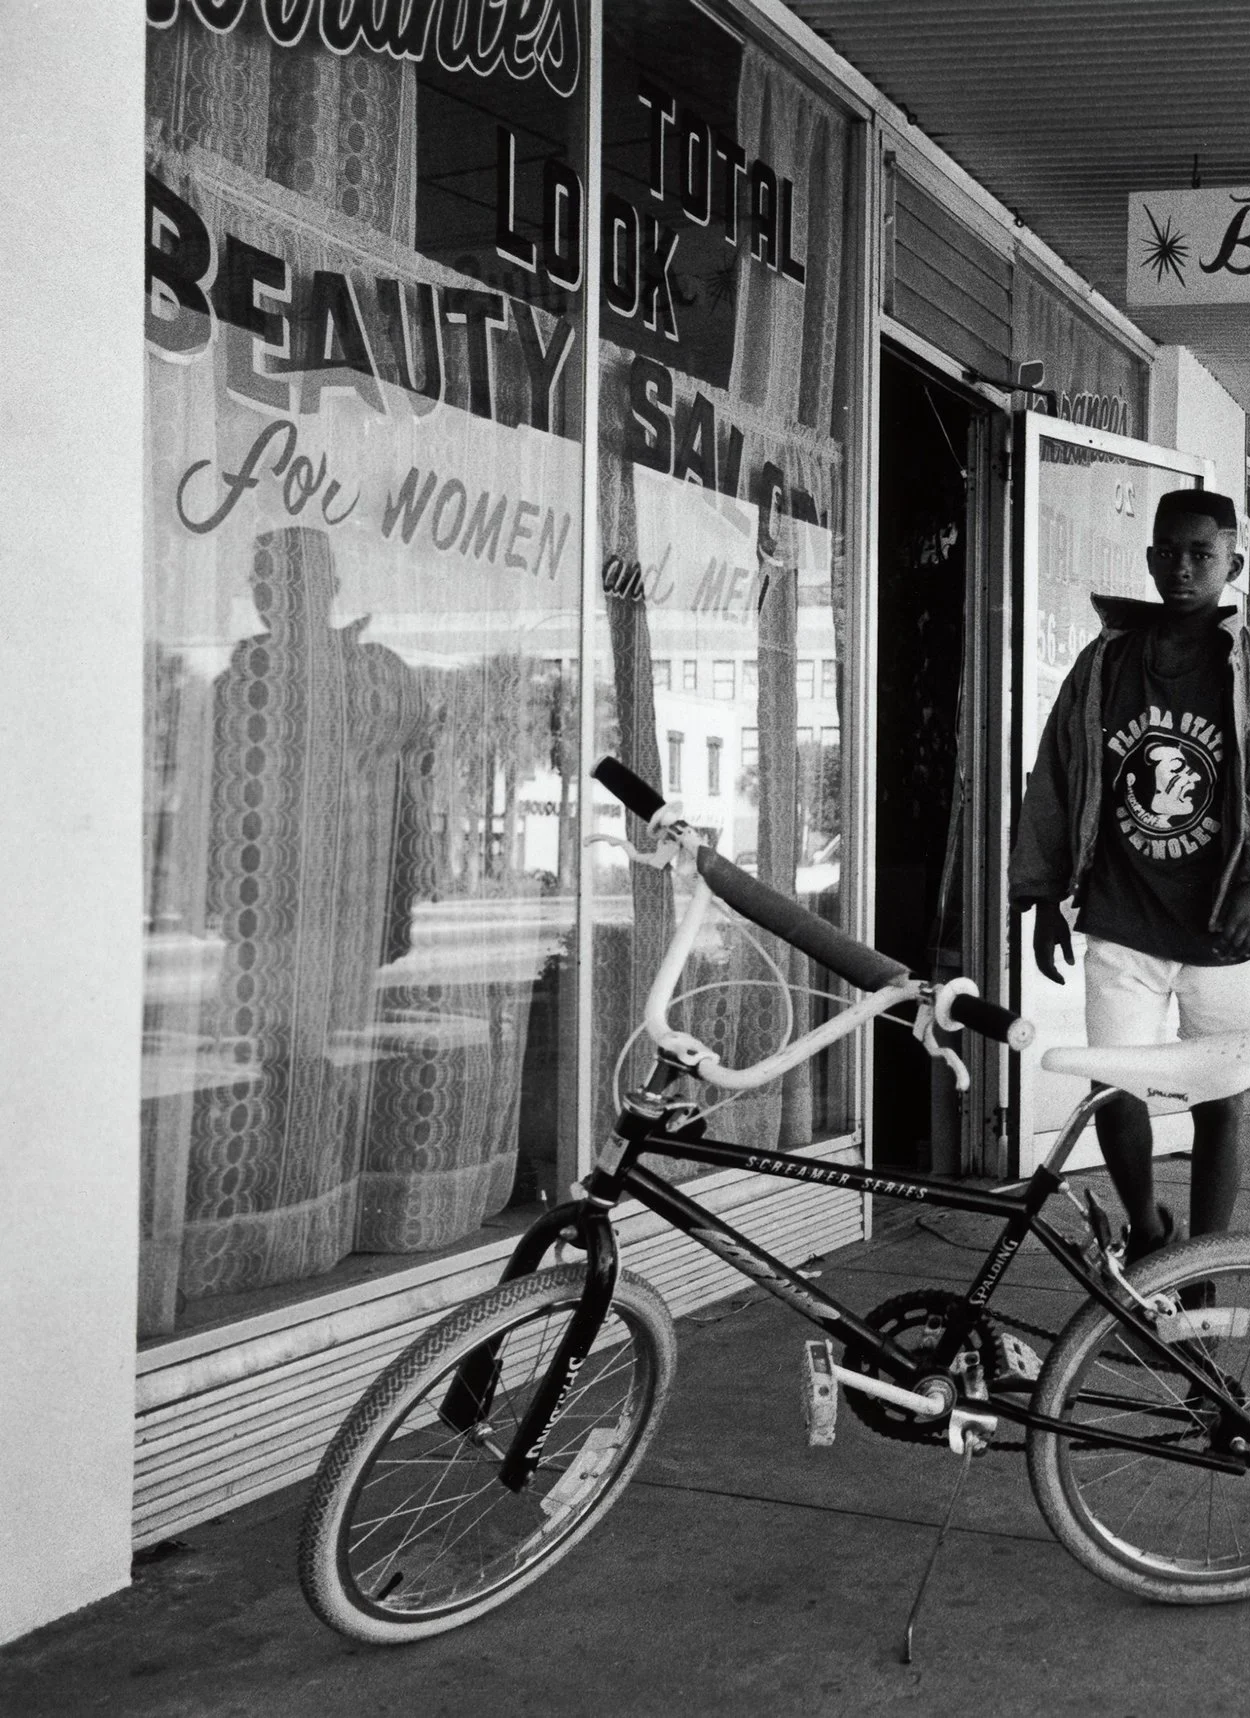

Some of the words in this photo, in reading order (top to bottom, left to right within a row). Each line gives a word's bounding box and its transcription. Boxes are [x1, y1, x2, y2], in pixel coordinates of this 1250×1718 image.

[496, 131, 680, 343] LOOK
[638, 86, 806, 286] TOTAL
[144, 168, 577, 436] BEAUTY
[381, 466, 570, 582] WOMEN
[969, 1236, 1019, 1306] SPALDING
